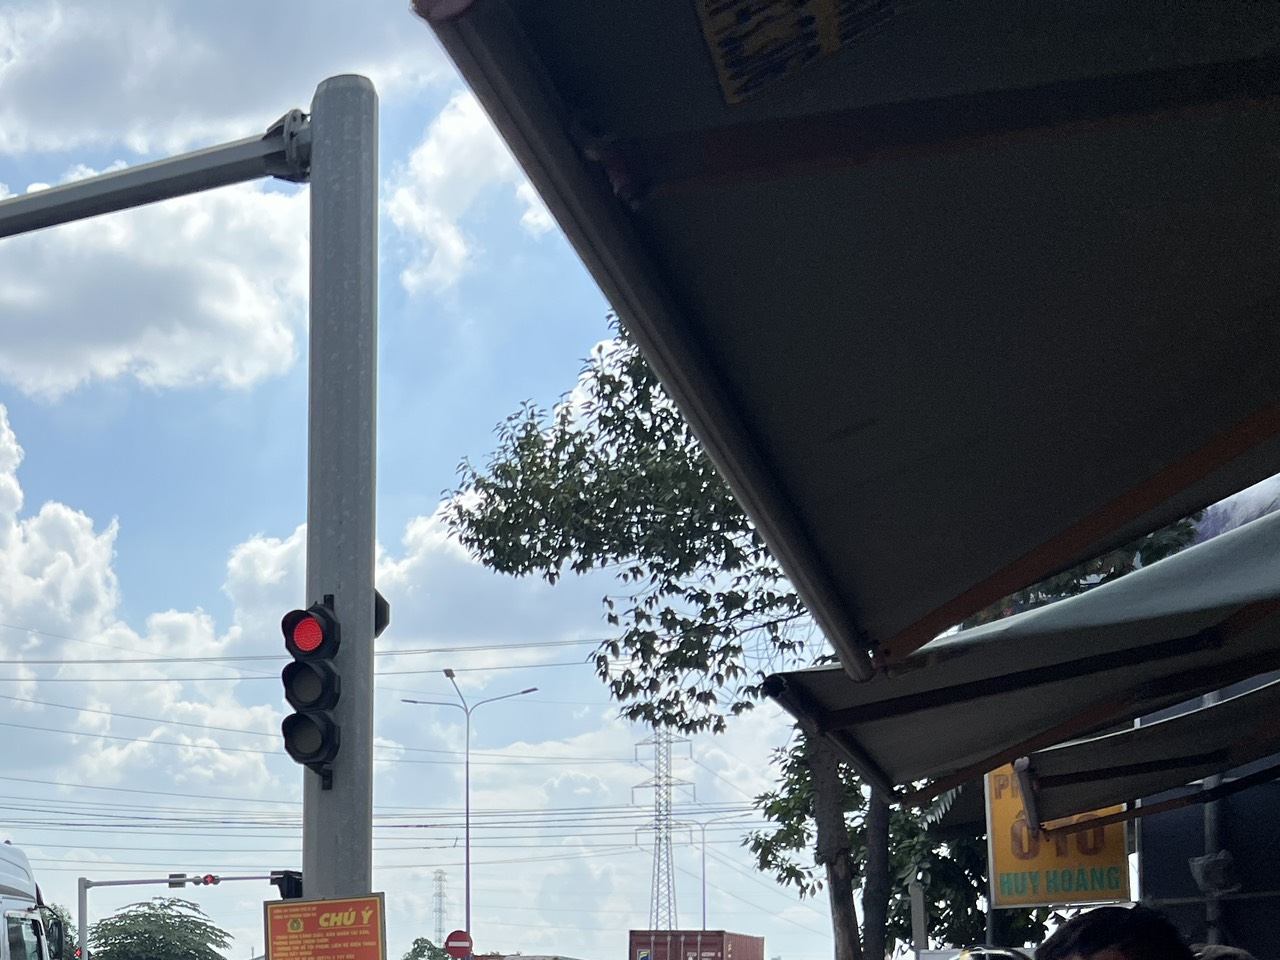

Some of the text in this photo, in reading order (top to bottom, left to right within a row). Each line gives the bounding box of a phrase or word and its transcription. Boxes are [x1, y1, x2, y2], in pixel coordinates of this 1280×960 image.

[1000, 863, 1120, 897] HUY HOÀNG
[319, 906, 374, 927] CHÚ Ý
